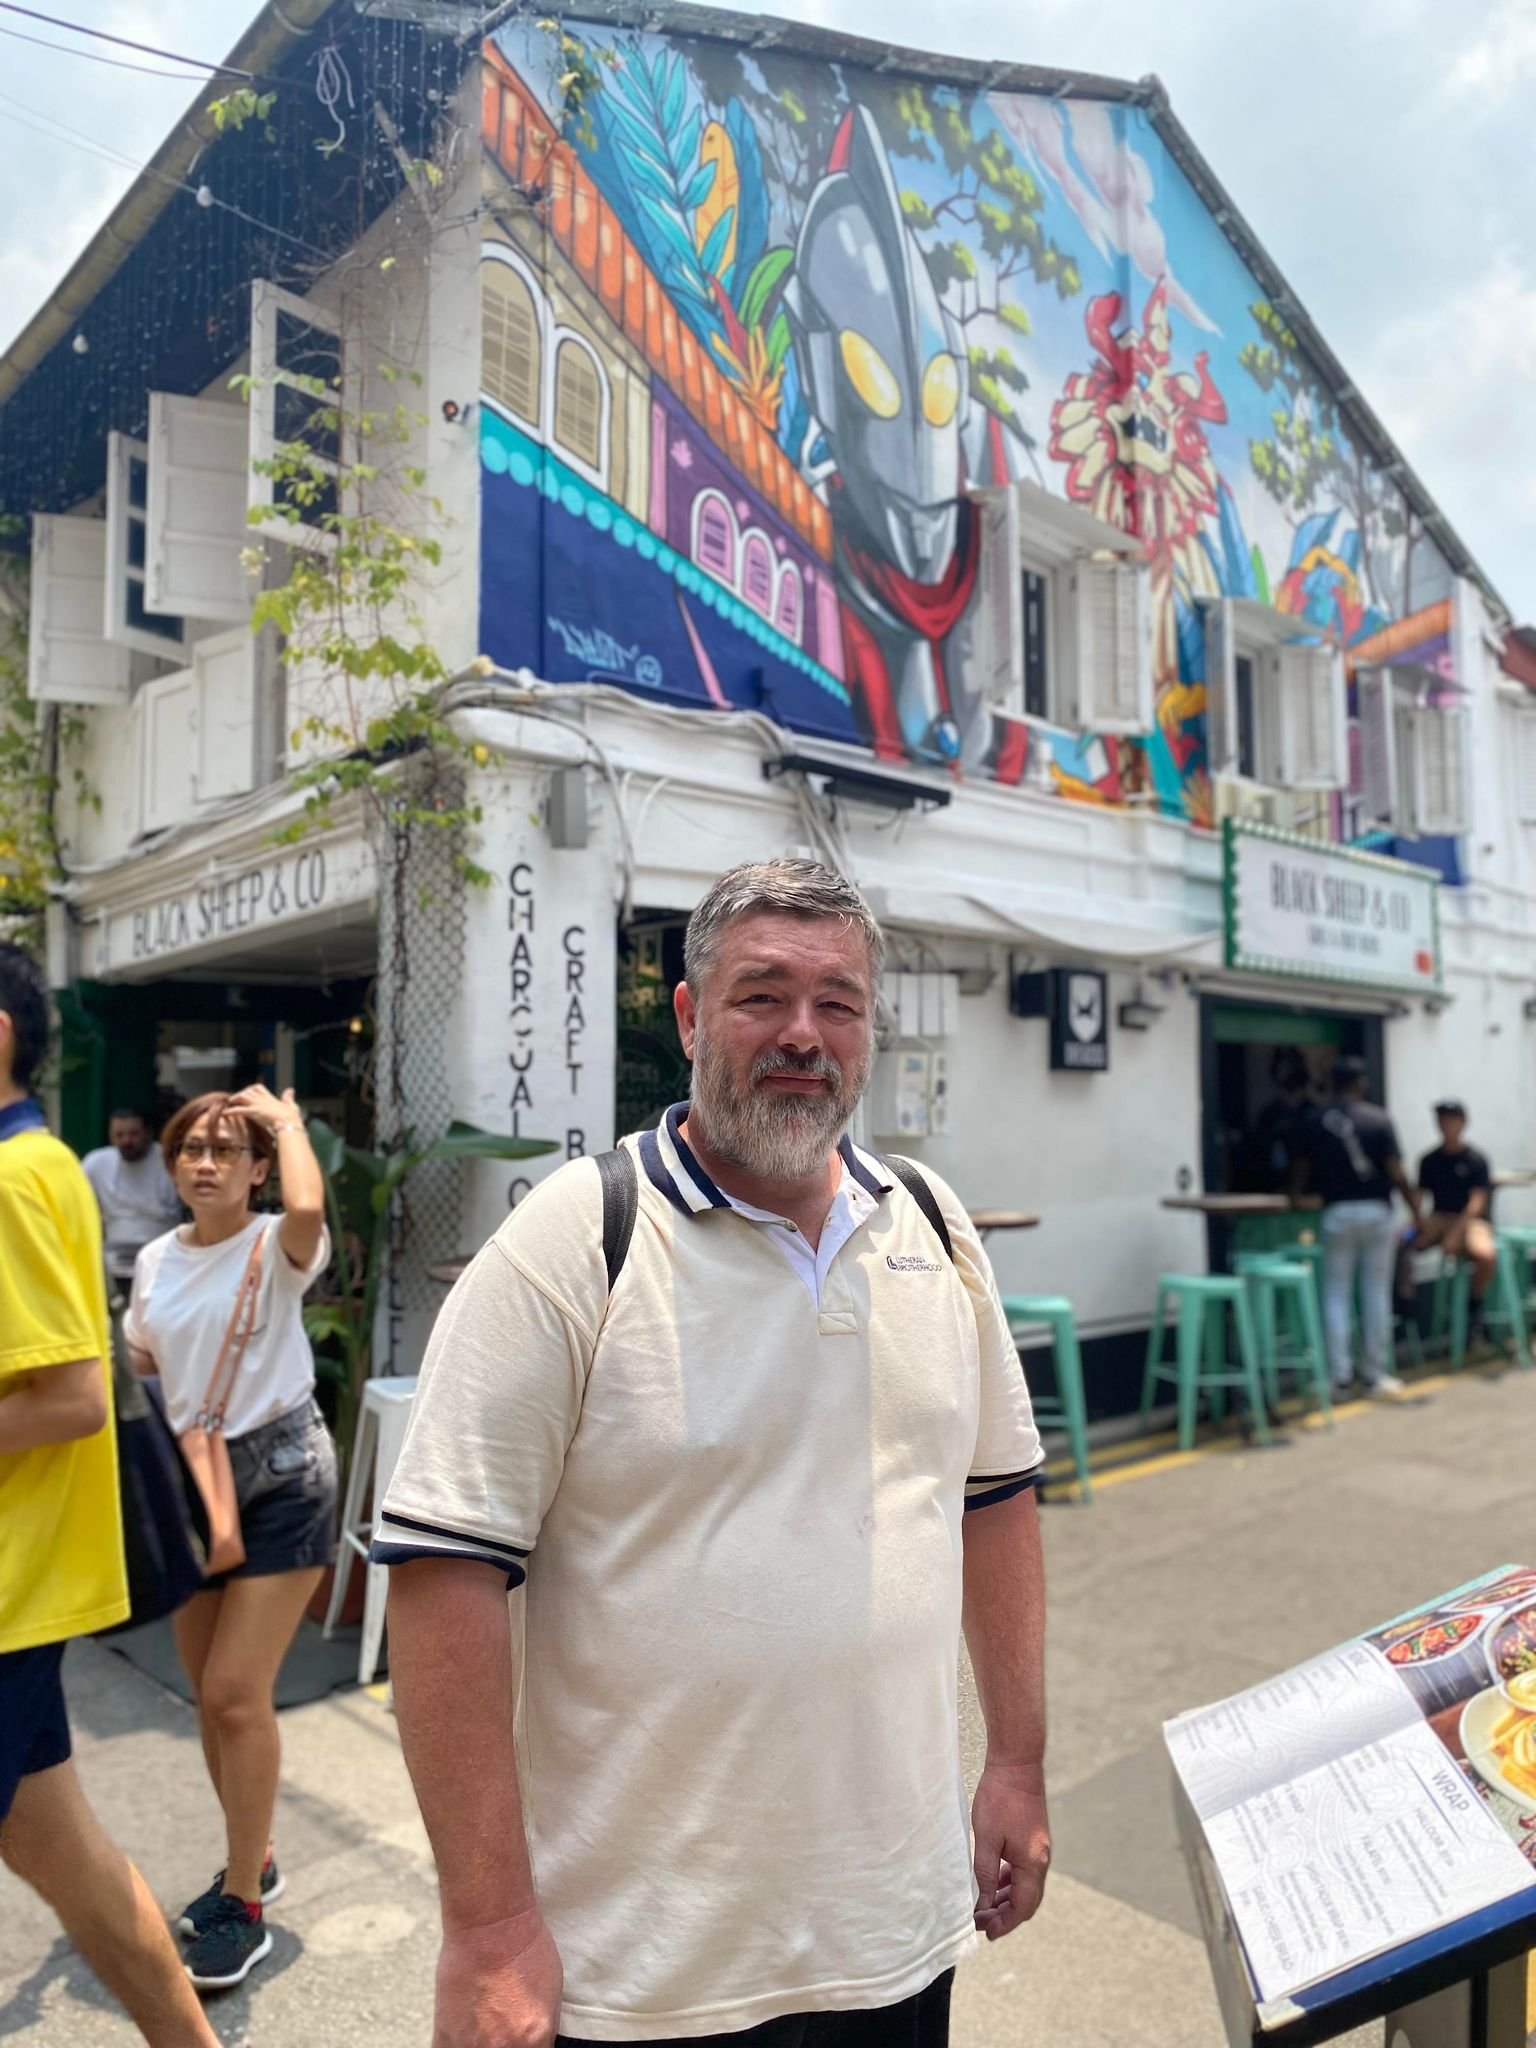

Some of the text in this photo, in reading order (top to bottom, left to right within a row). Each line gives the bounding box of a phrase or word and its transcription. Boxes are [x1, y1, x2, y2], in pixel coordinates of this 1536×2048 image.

[133, 849, 326, 957] BLACK SHEEP & CO
[561, 925, 586, 1095] CRAFT
[1430, 1768, 1470, 1814] WRAP
